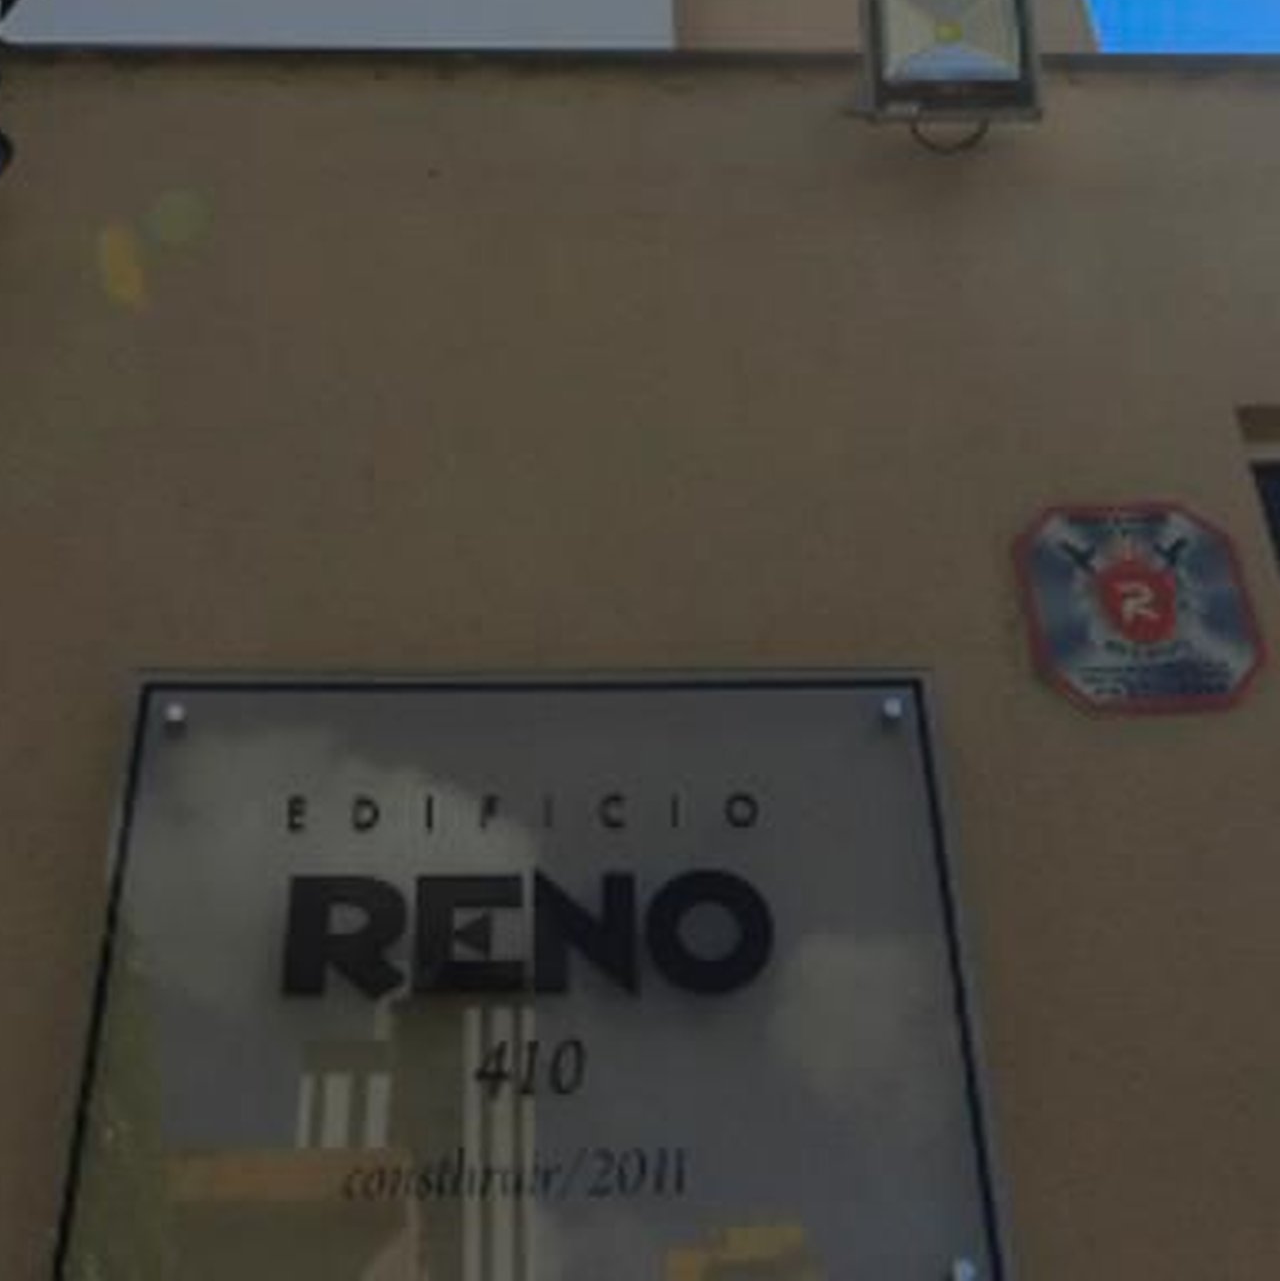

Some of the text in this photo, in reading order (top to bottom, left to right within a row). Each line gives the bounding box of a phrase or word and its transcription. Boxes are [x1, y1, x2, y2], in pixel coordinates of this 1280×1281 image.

[286, 793, 760, 833] EDIFICIO
[281, 868, 775, 1000] RENO
[475, 1039, 586, 1097] 410
